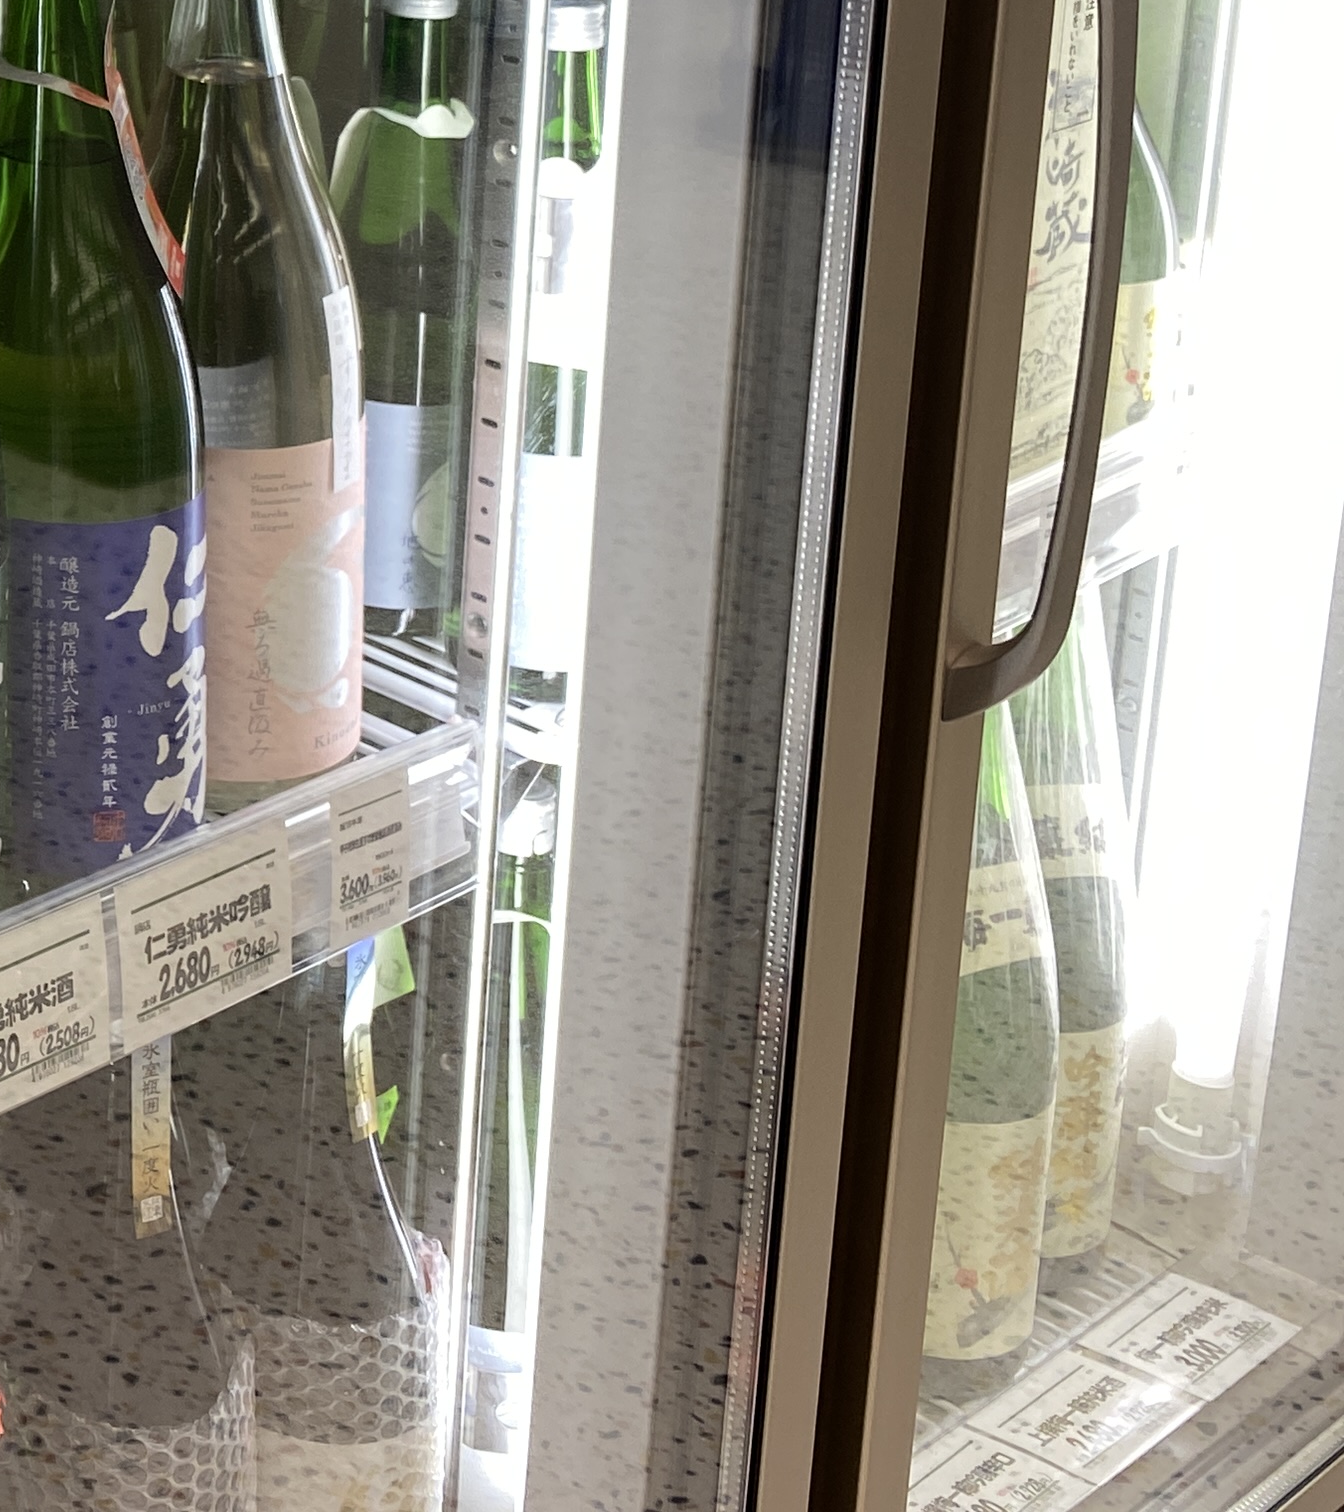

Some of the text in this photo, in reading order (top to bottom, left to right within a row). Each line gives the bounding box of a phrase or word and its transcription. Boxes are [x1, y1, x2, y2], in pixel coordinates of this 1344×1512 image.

[137, 700, 171, 716] Jinyu
[145, 884, 271, 964] 仁勇純米吟醸
[159, 946, 219, 1001] 2,680円
